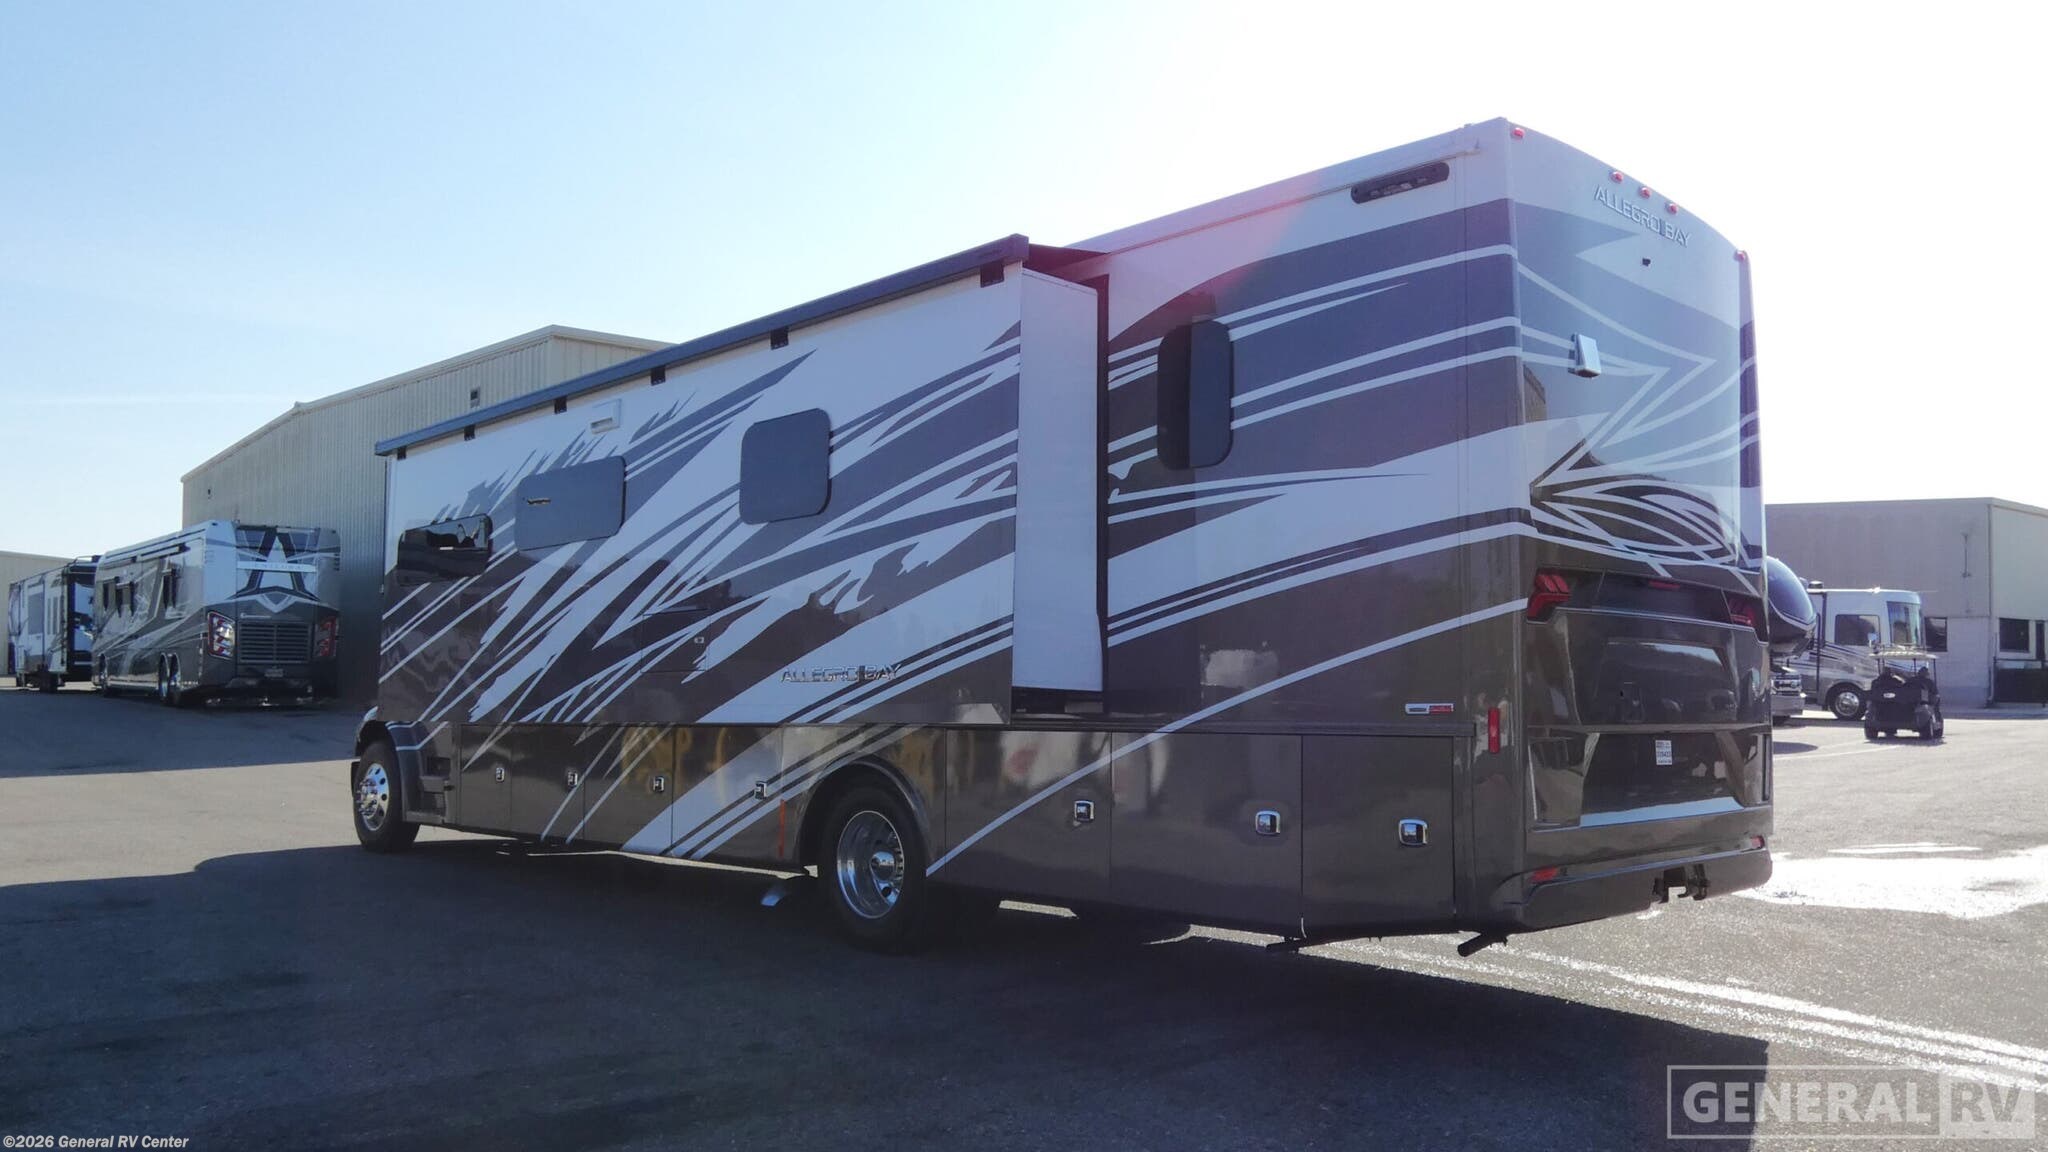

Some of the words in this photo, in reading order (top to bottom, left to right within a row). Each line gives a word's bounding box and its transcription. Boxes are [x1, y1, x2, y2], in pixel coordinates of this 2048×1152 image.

[1594, 184, 1661, 233] ALLEGRO
[1664, 221, 1691, 248] BAY
[781, 665, 859, 683] ALLEGRO
[863, 663, 902, 681] BAY
